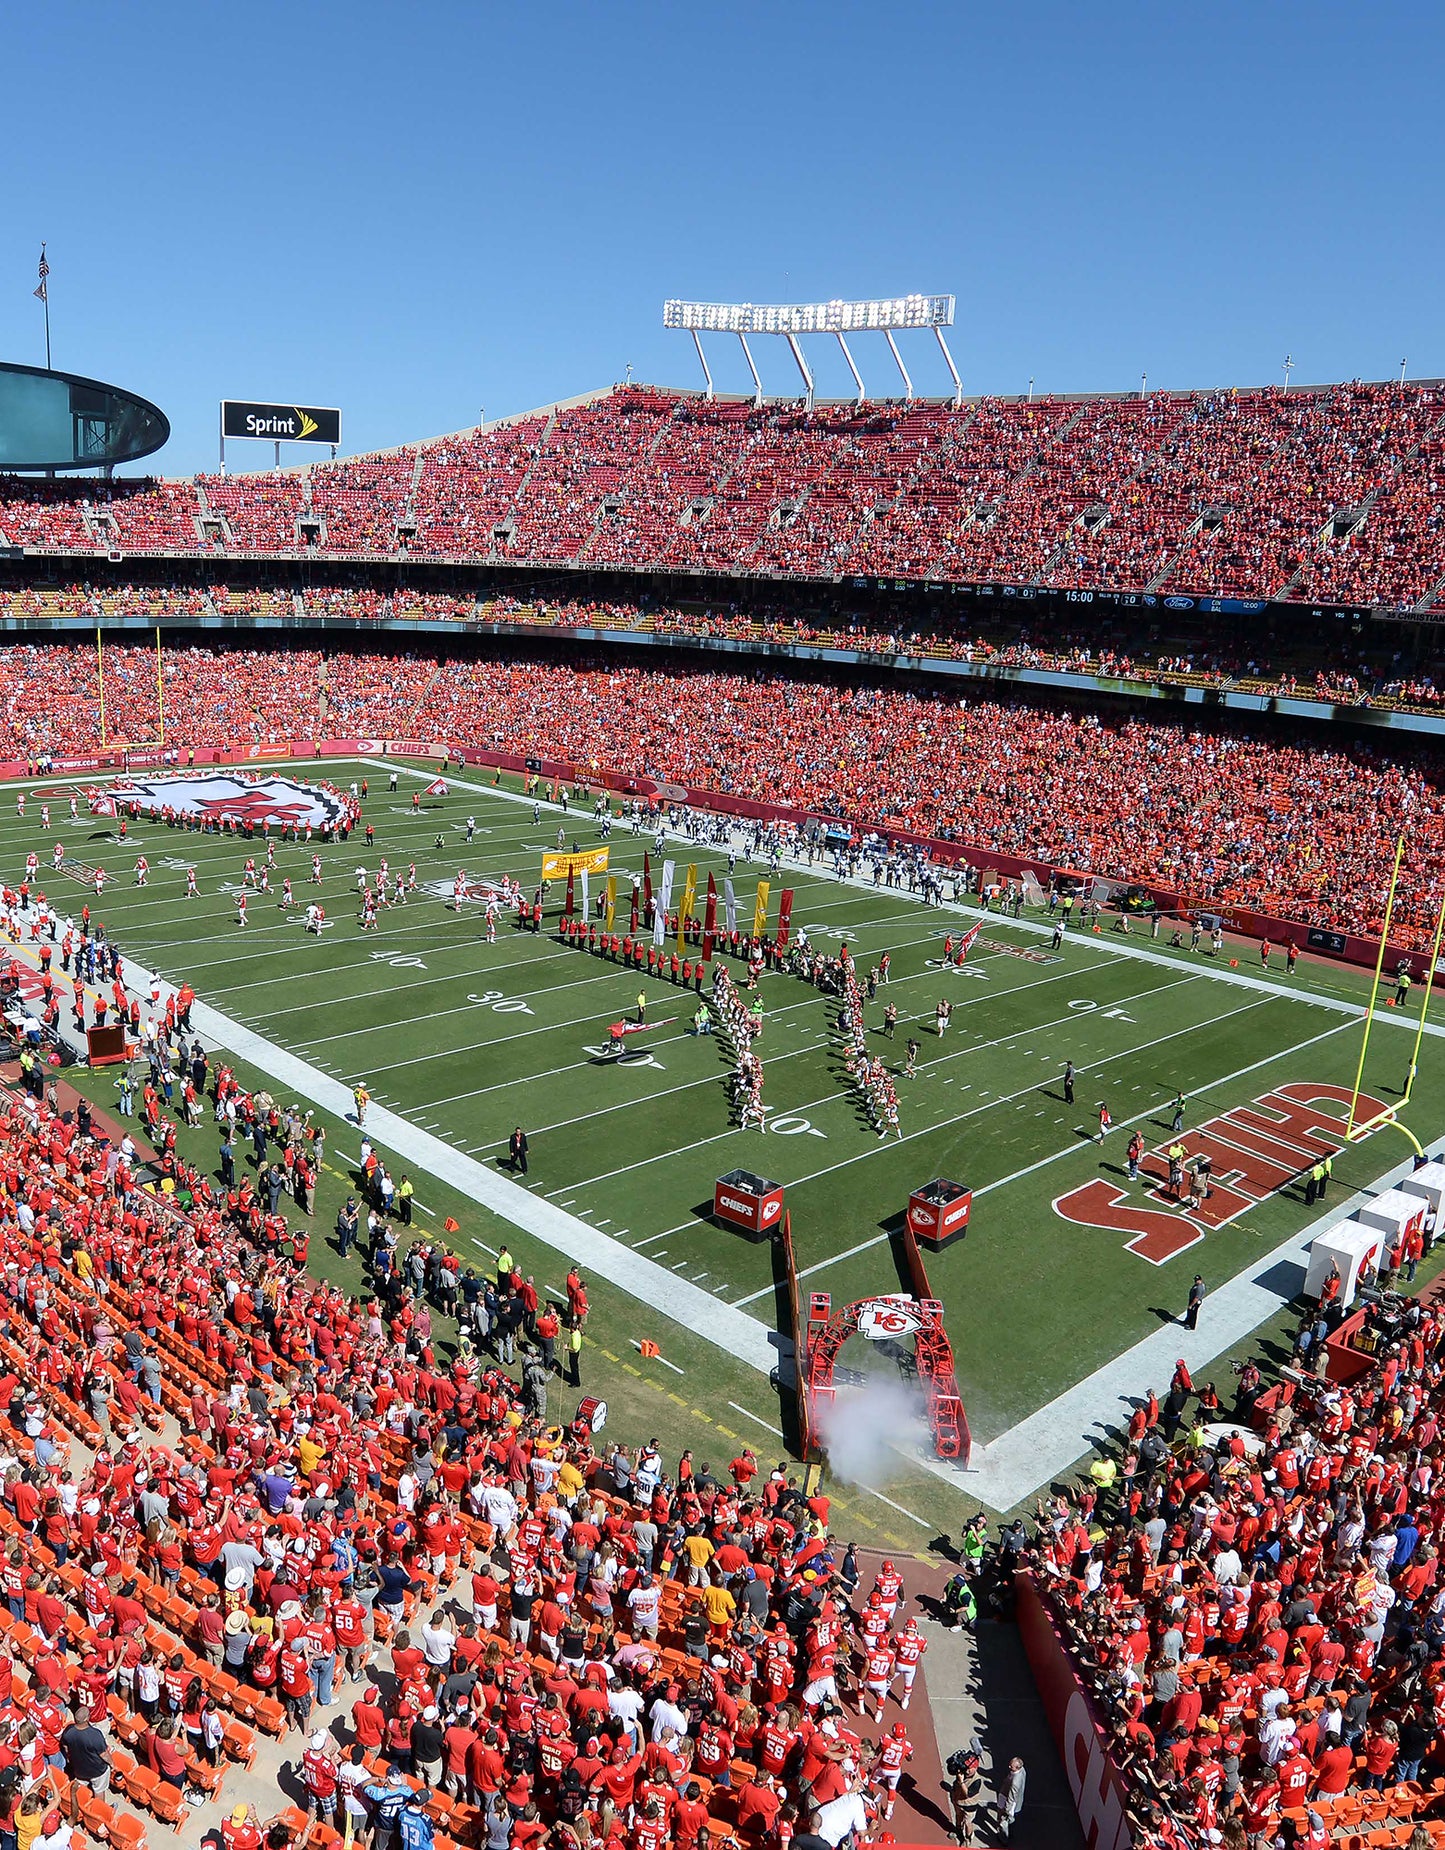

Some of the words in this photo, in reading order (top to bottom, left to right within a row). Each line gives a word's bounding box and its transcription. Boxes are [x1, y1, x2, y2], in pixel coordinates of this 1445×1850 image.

[246, 414, 295, 436] Sprint
[1023, 589, 1028, 597] 0
[1065, 591, 1094, 603] 15:00
[1130, 596, 1136, 604] 0
[1169, 599, 1189, 608] Ford
[391, 742, 430, 755] CHIEFS
[575, 773, 605, 785] FOOTBALL
[591, 770, 601, 778] TO
[1220, 907, 1234, 917] TO
[467, 990, 528, 1014] 30
[1051, 1082, 1398, 1267] CHIEFS
[720, 1195, 754, 1218] CHIEFS
[873, 1310, 906, 1333] KC
[525, 1531, 541, 1547] 58
[881, 1585, 899, 1597] 97
[335, 1614, 354, 1631] 58
[867, 1619, 887, 1633] 92
[870, 1660, 891, 1676] 90
[77, 1687, 96, 1708] 91
[766, 1740, 785, 1760] 58
[882, 1748, 903, 1766] 21
[1289, 1771, 1307, 1788] 00
